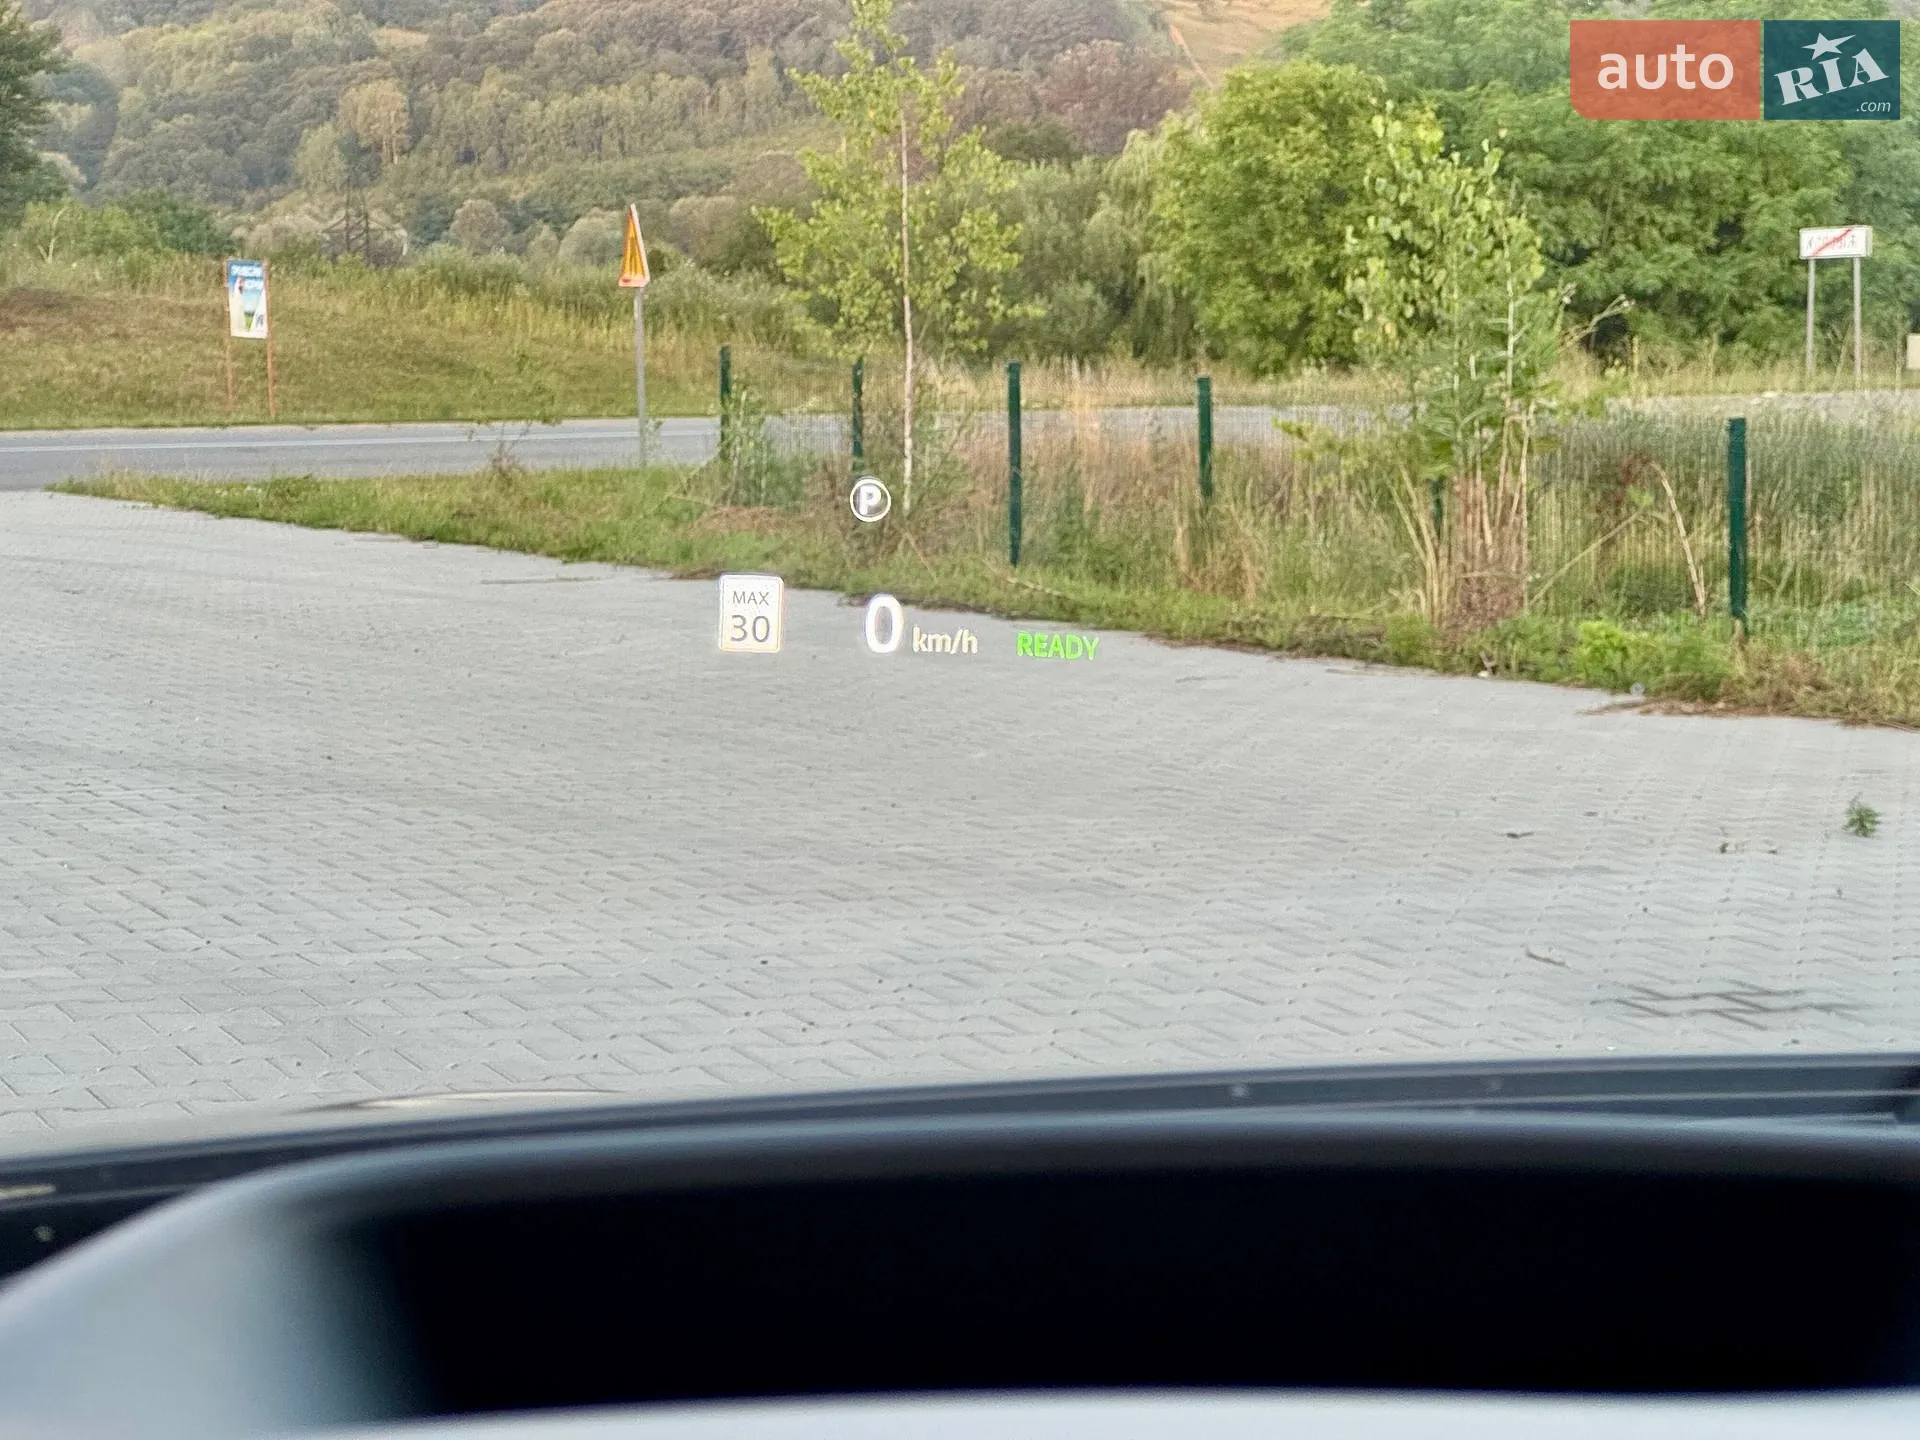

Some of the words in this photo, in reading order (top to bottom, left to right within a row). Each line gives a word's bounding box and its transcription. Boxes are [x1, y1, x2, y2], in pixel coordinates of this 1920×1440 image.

[857, 484, 882, 516] P
[731, 590, 770, 606] MAX
[730, 614, 771, 643] 30
[865, 593, 904, 654] 0
[912, 626, 978, 655] km/h
[1016, 631, 1100, 661] READY
